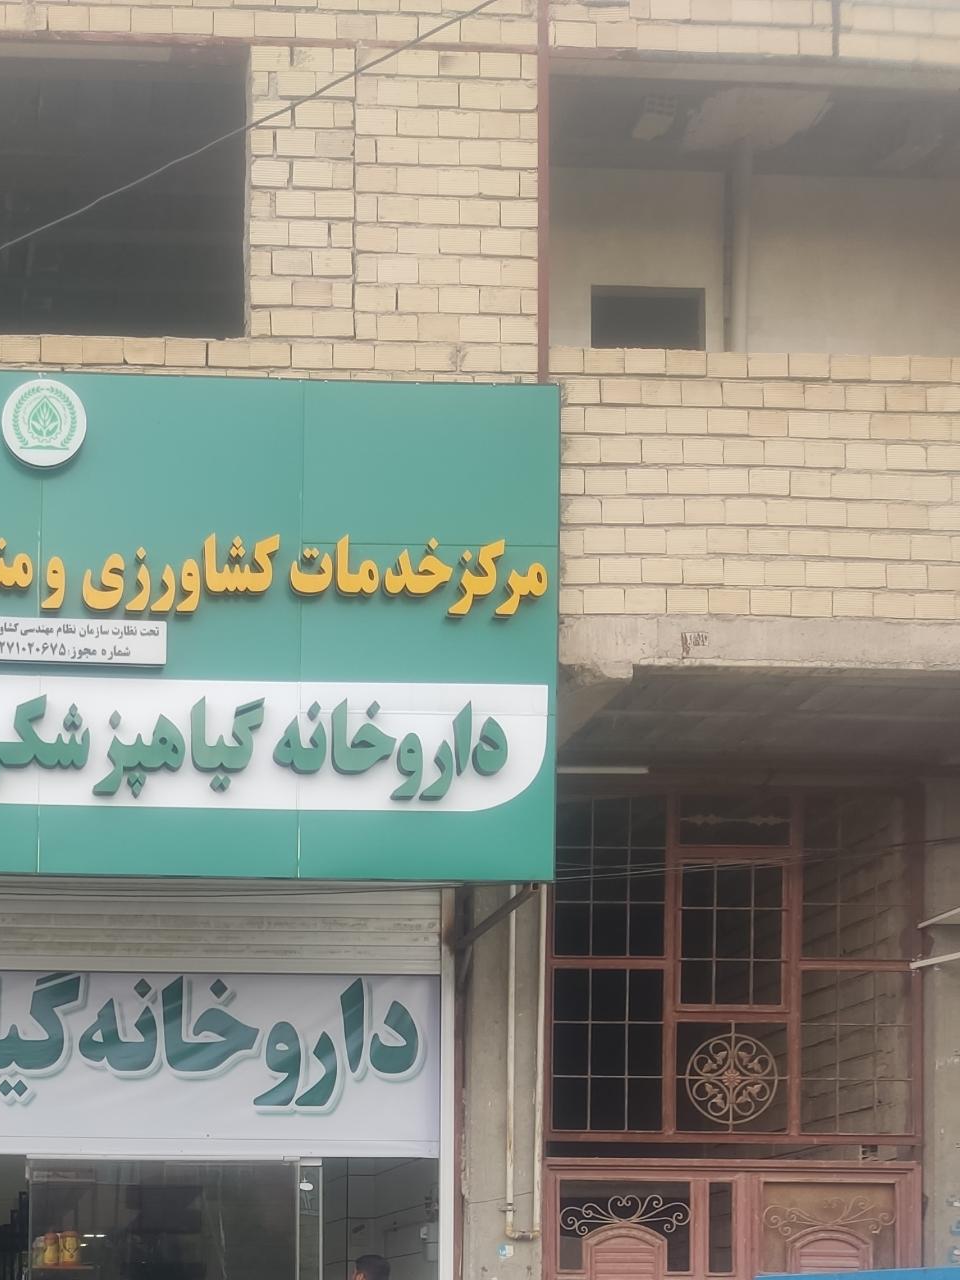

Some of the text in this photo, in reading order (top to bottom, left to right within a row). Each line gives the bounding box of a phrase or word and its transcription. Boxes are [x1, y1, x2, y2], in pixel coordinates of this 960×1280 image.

[83, 533, 280, 613] کشاورزی
[290, 534, 454, 596] خدمات
[445, 538, 549, 618] مرکز
[43, 556, 65, 610] و
[20, 624, 55, 636] مهندسی
[56, 624, 77, 636] نظام
[79, 625, 110, 637] سازمان
[111, 626, 138, 637] نظارت
[140, 627, 160, 637] تحت
[100, 645, 131, 660] شماره
[273, 699, 509, 801] داروخانه
[80, 976, 420, 1108] داروخانه
